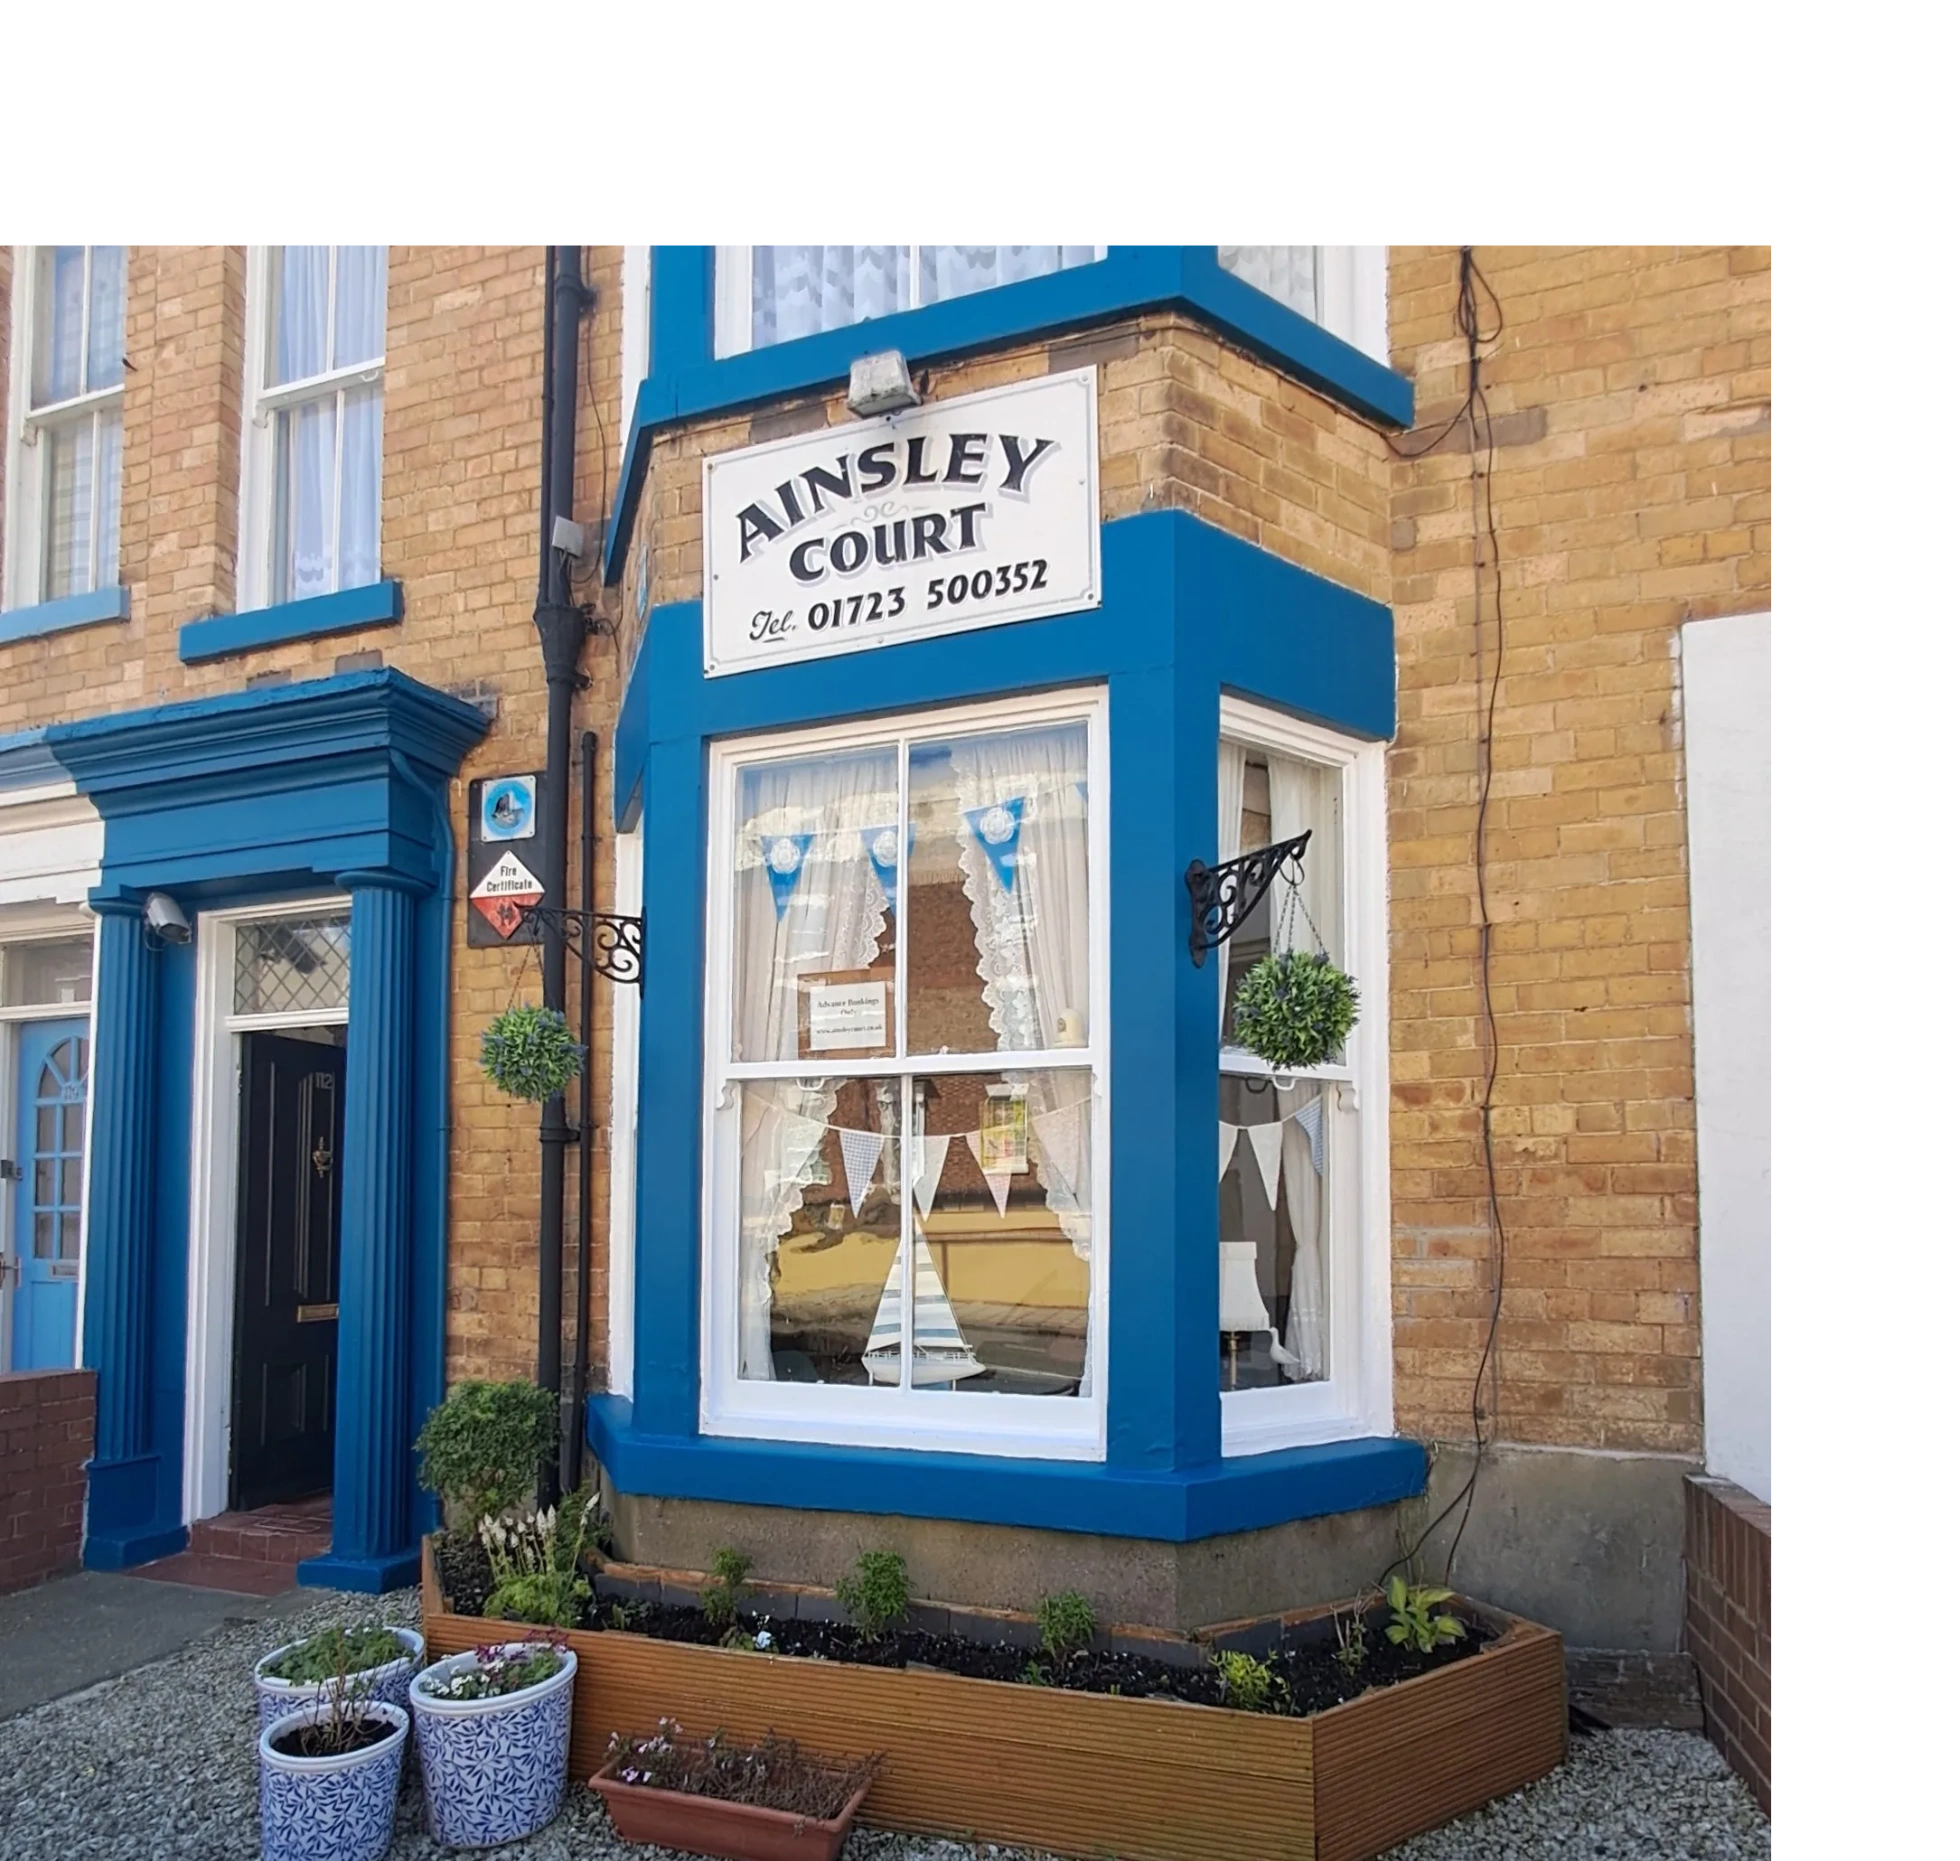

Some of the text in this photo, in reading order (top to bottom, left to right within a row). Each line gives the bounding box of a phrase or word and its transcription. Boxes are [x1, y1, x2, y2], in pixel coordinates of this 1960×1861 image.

[735, 433, 1056, 563] AINSLEY
[789, 502, 988, 583] COURT
[748, 559, 1049, 643] Tel. 01723 500352
[500, 866, 517, 876] Fire
[487, 880, 533, 892] Certificate
[816, 998, 879, 1008] Advance Bookings
[315, 1071, 332, 1089] 112
